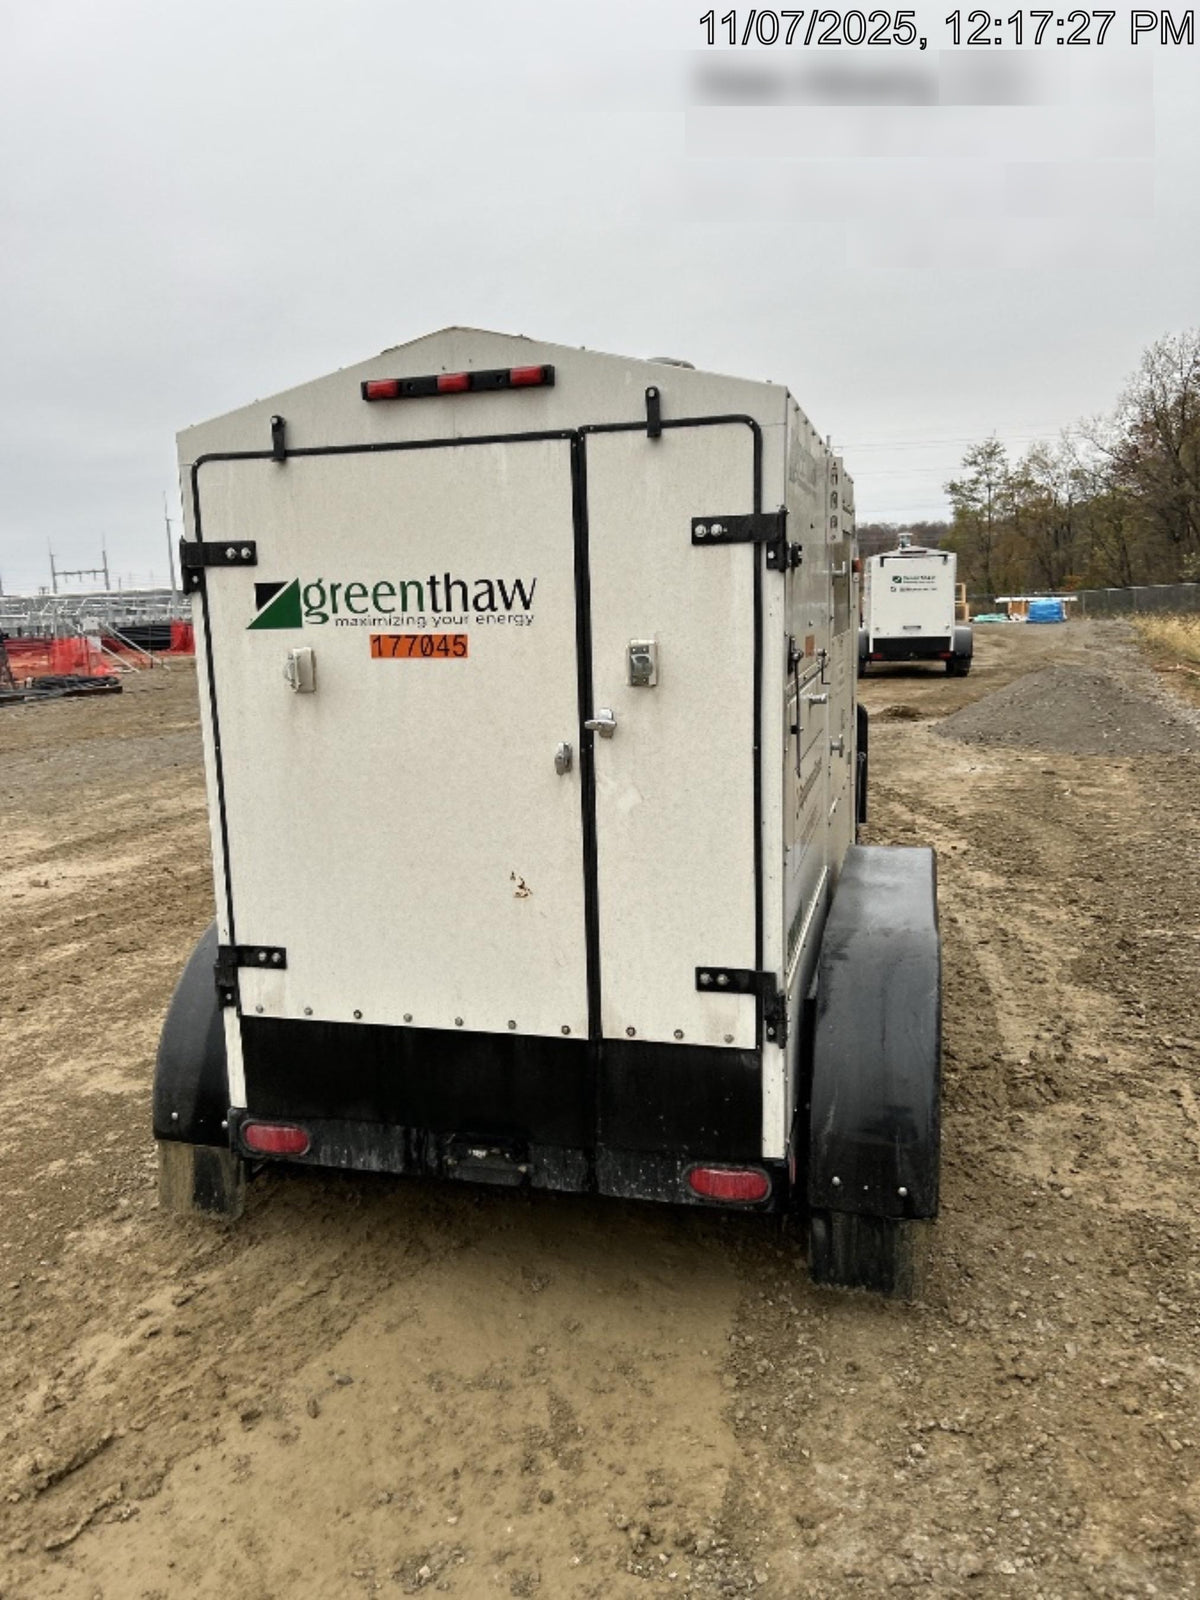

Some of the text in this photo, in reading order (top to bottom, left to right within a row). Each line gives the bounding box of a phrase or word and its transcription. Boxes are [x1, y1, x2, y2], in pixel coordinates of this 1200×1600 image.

[302, 572, 537, 625] greenthaw
[334, 612, 535, 628] maximizing your energy
[372, 635, 467, 658] 177045
